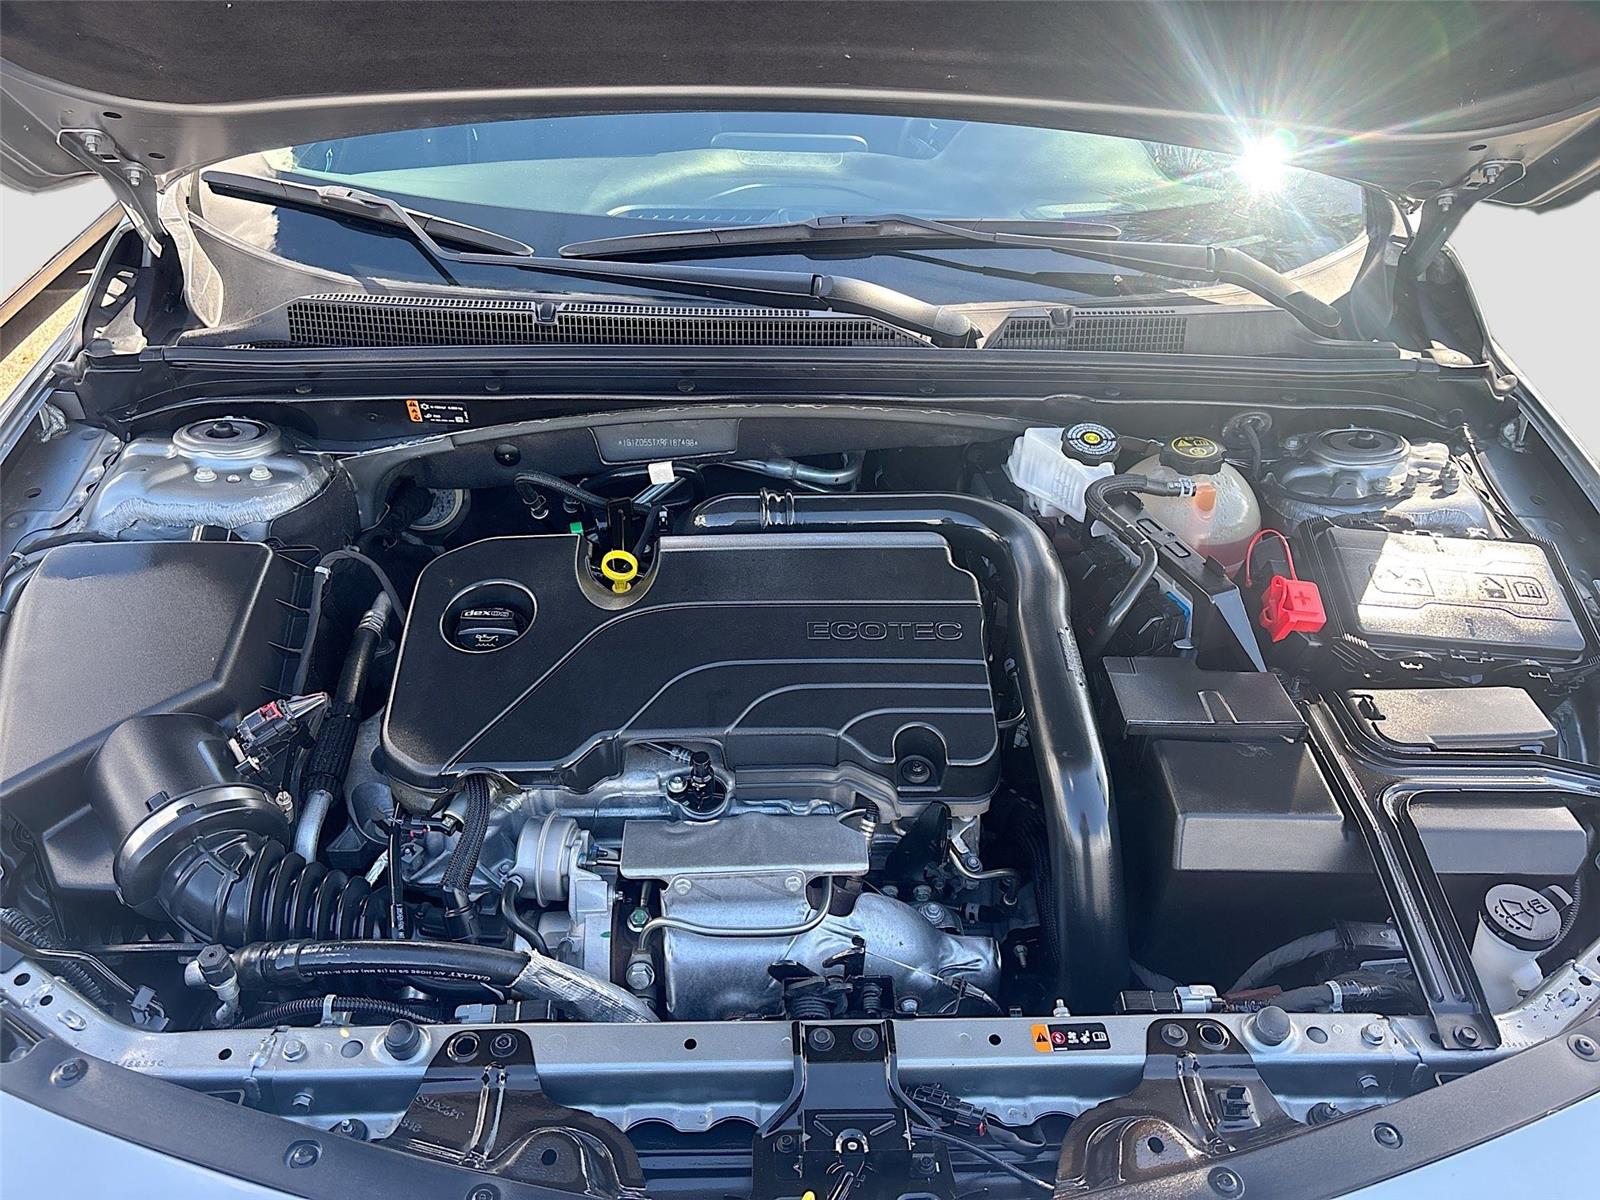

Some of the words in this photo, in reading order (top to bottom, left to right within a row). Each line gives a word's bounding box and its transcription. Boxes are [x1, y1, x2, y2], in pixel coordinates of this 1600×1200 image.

[464, 609, 510, 618] dexos
[806, 621, 963, 641] ECOTEC
[448, 971, 491, 981] GALAXY
